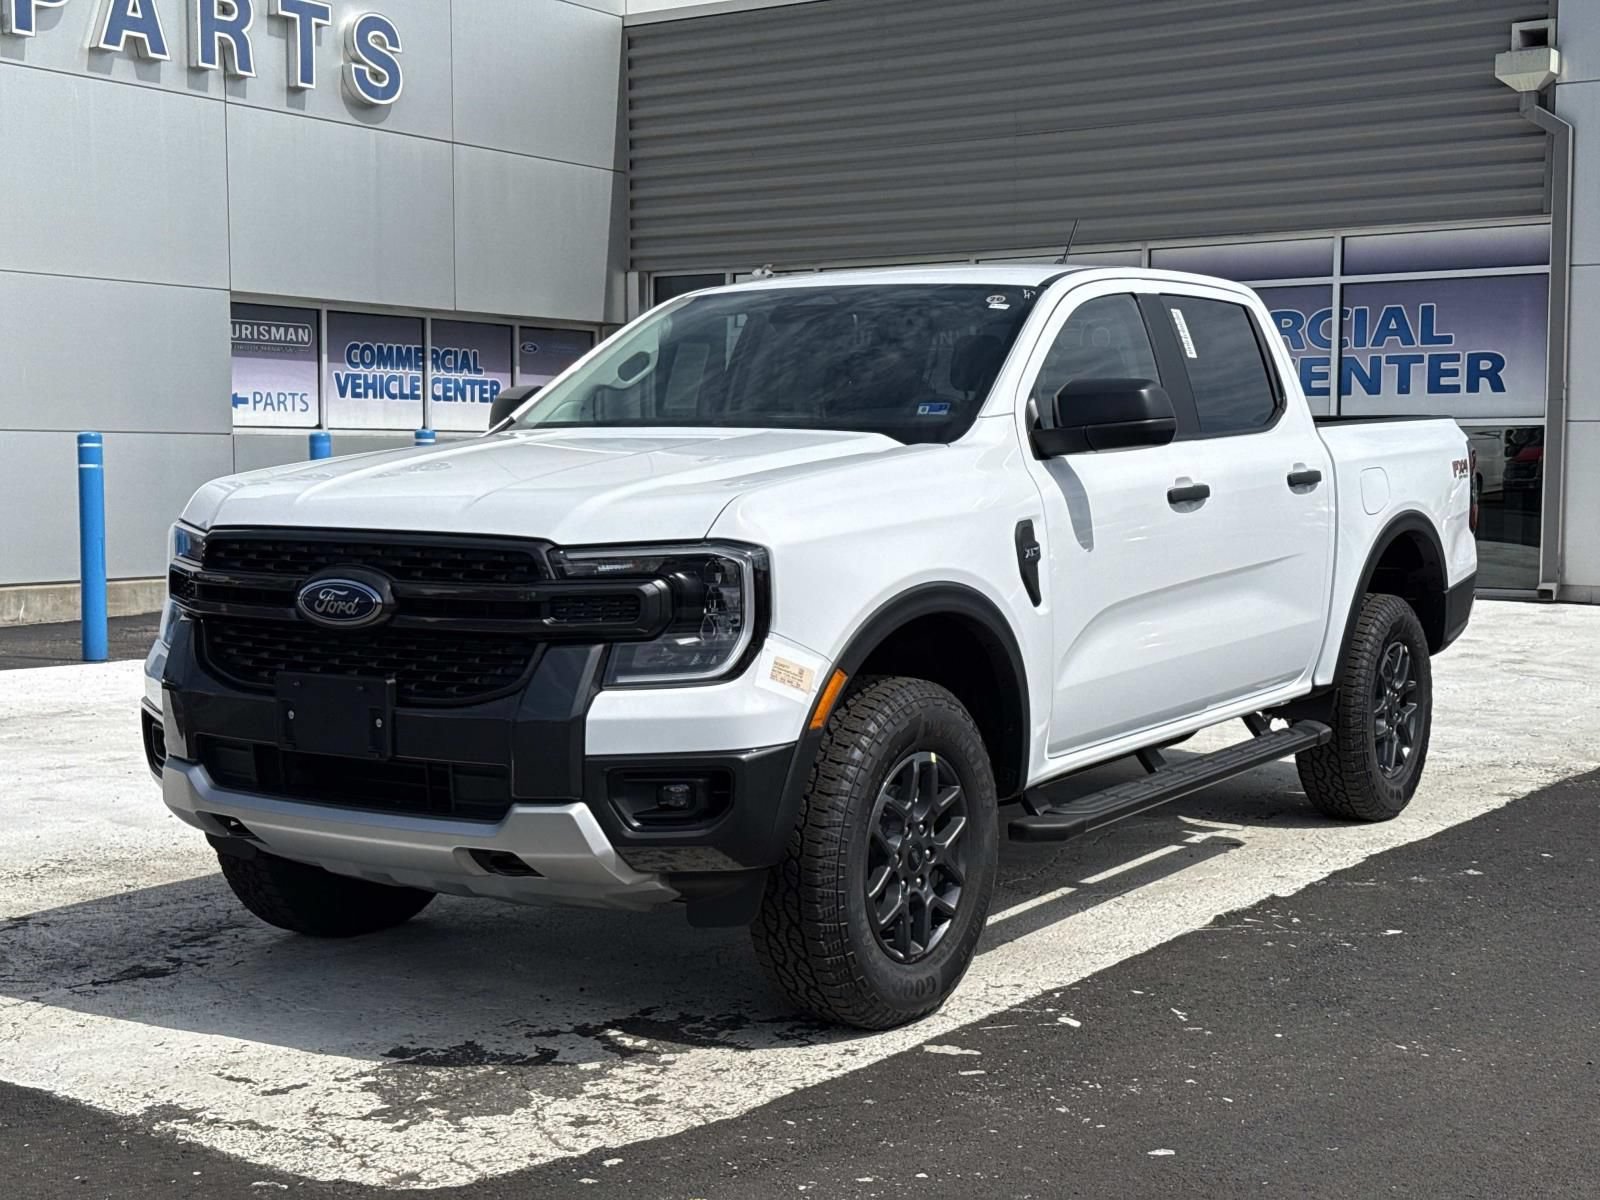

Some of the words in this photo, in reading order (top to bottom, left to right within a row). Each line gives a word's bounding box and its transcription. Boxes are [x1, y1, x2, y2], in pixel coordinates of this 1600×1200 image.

[344, 340, 484, 376] COMMERCIAL
[334, 371, 422, 401] VEHICLE
[1290, 352, 1507, 398] ENTER
[252, 391, 309, 413] PARTS
[315, 587, 360, 615] Ford
